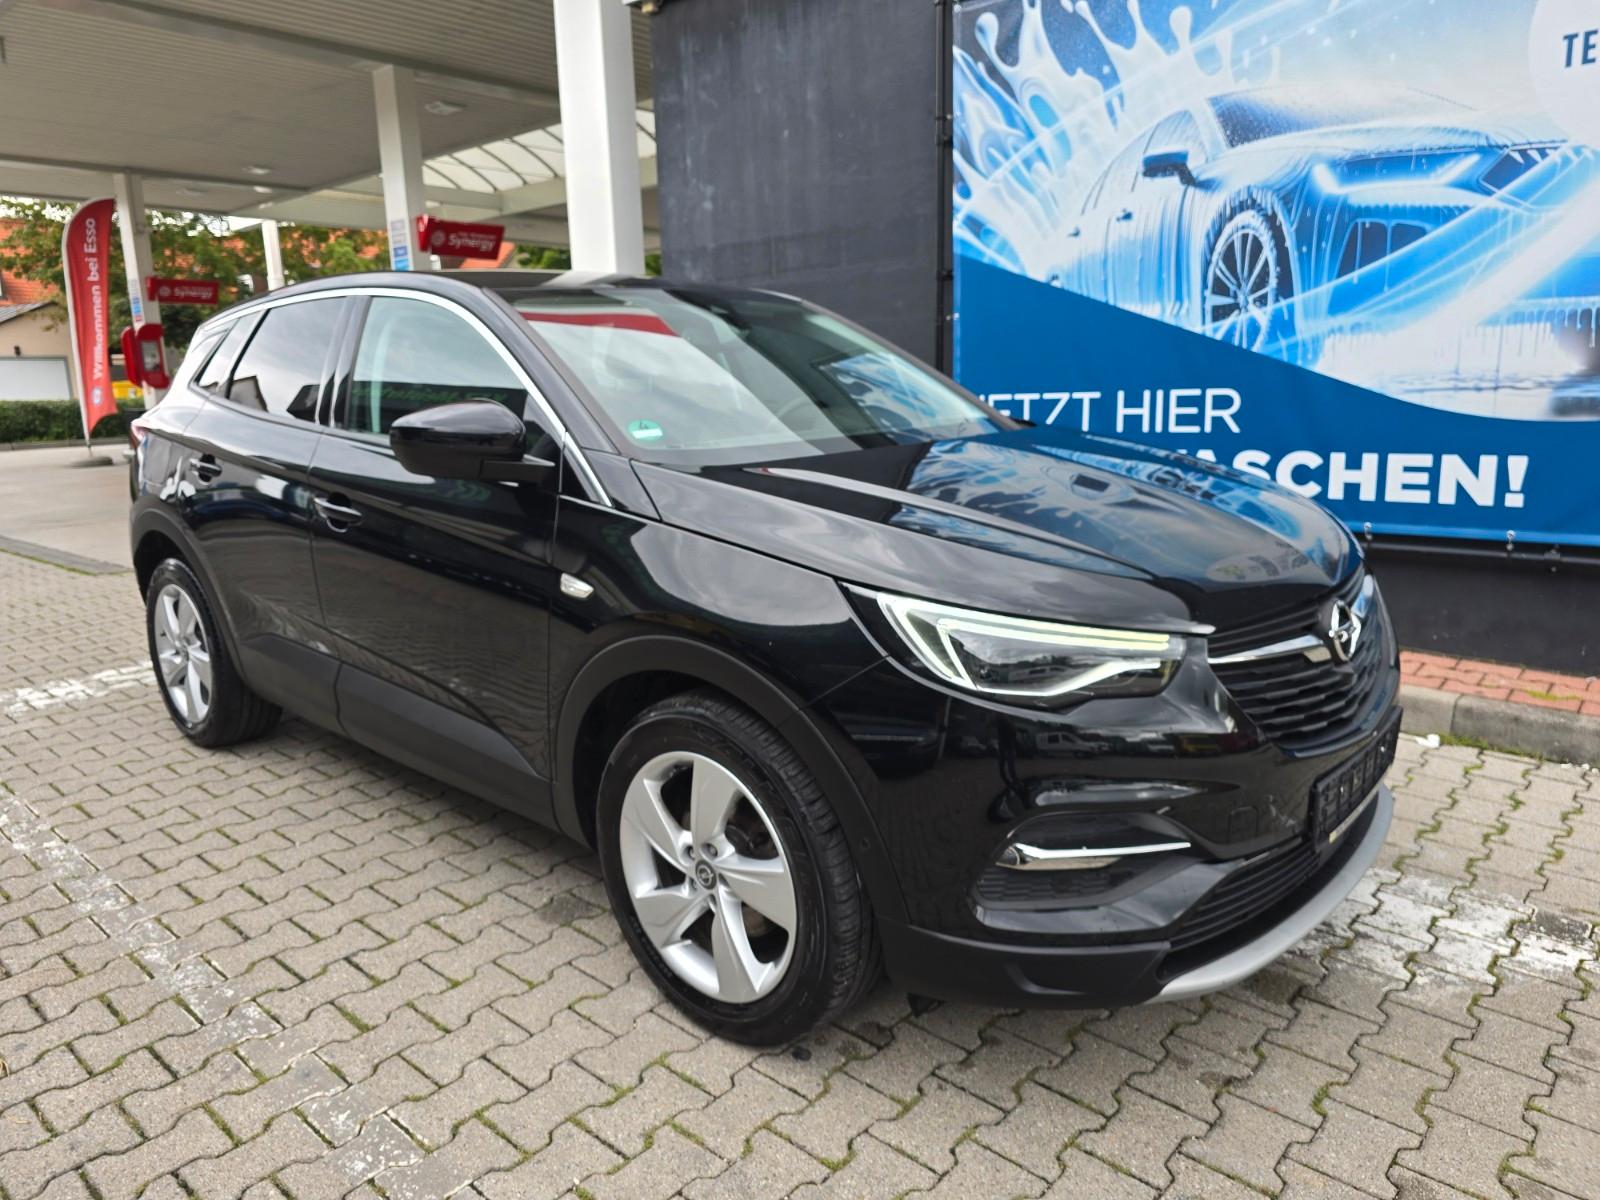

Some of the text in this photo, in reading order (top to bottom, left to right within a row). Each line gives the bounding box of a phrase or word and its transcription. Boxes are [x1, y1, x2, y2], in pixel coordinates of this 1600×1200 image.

[1563, 28, 1599, 68] TE
[84, 218, 97, 253] Esso
[447, 232, 497, 252] Synergy
[85, 257, 99, 281] bei
[91, 284, 103, 380] Willkommen
[979, 387, 1242, 434] ETZT HIER
[1177, 449, 1529, 508] SCHEN!
